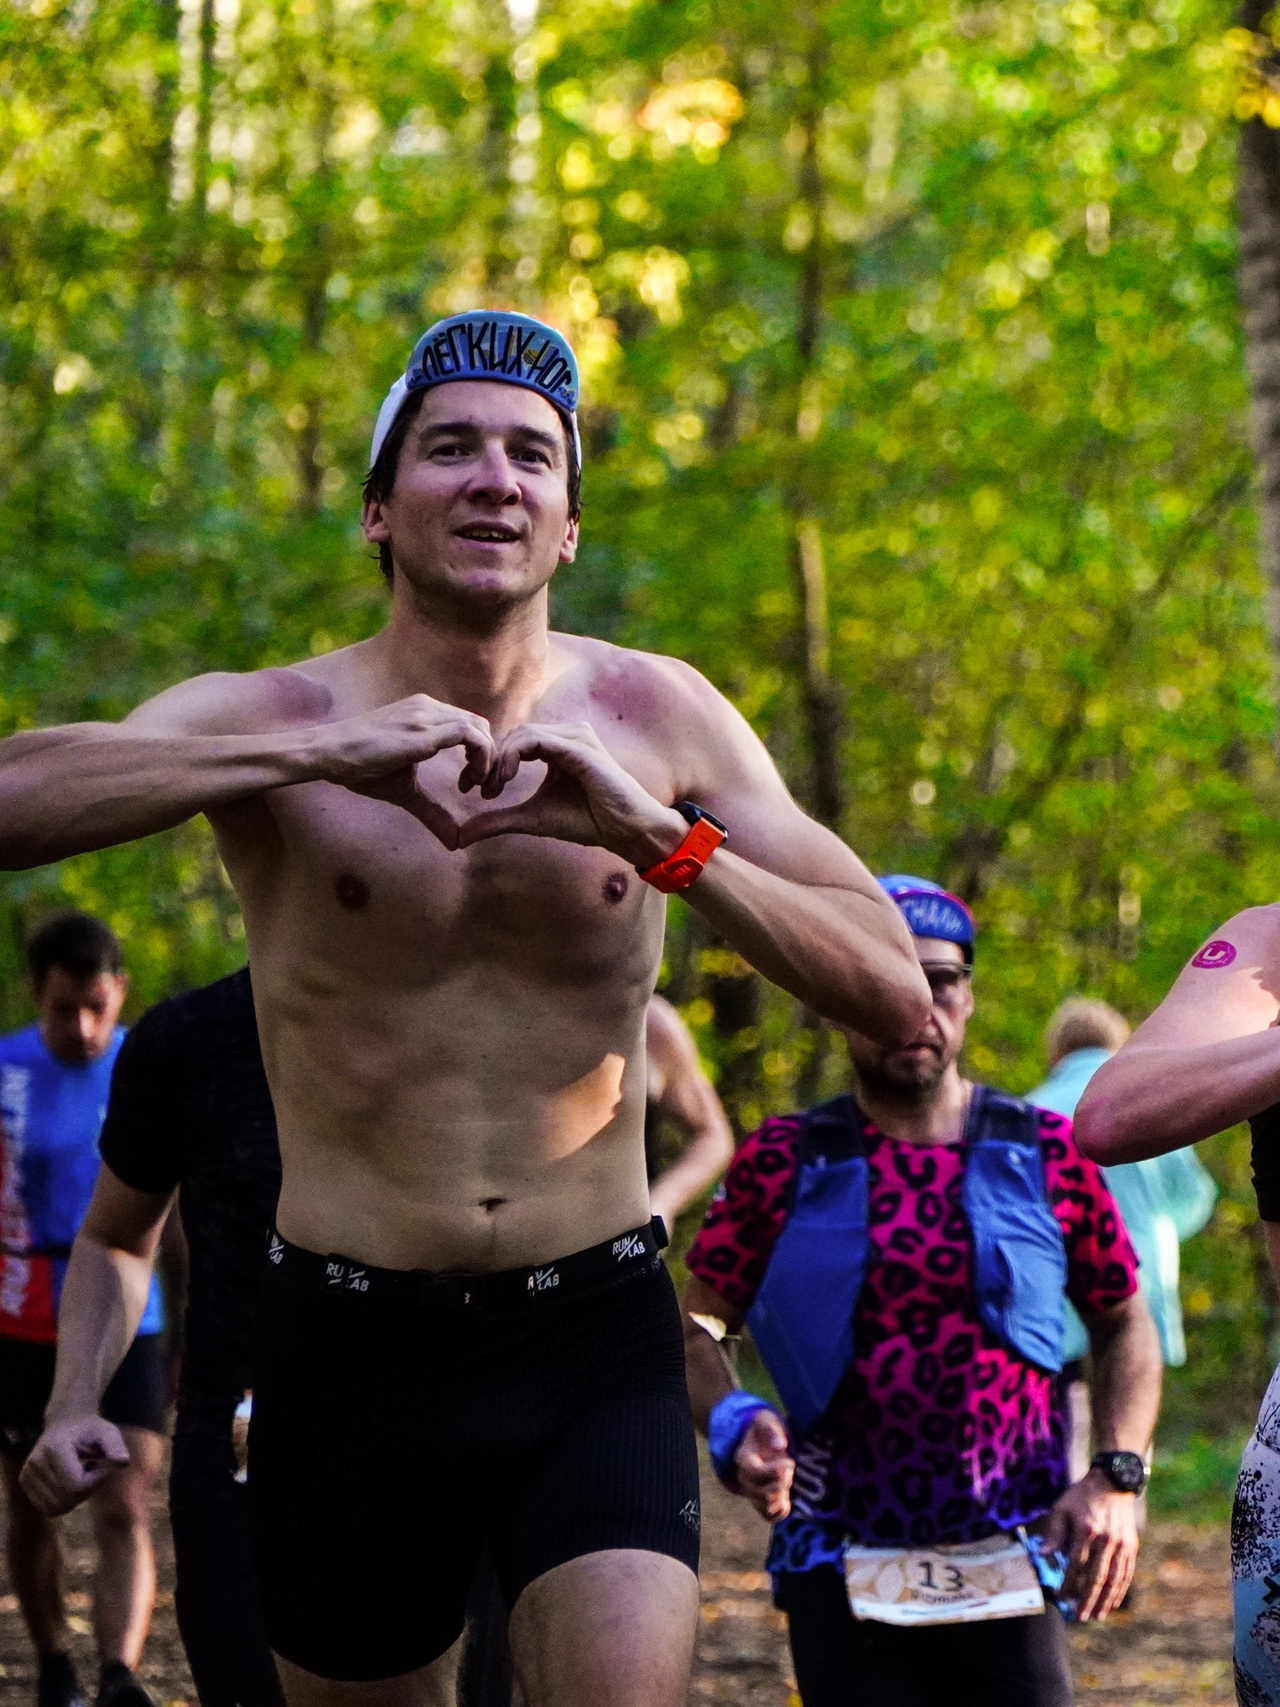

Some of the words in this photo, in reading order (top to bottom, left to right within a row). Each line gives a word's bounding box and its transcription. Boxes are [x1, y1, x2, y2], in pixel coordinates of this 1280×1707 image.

[526, 340, 572, 394] НОГ
[628, 1241, 646, 1258] LAB
[919, 1561, 966, 1593] 13
